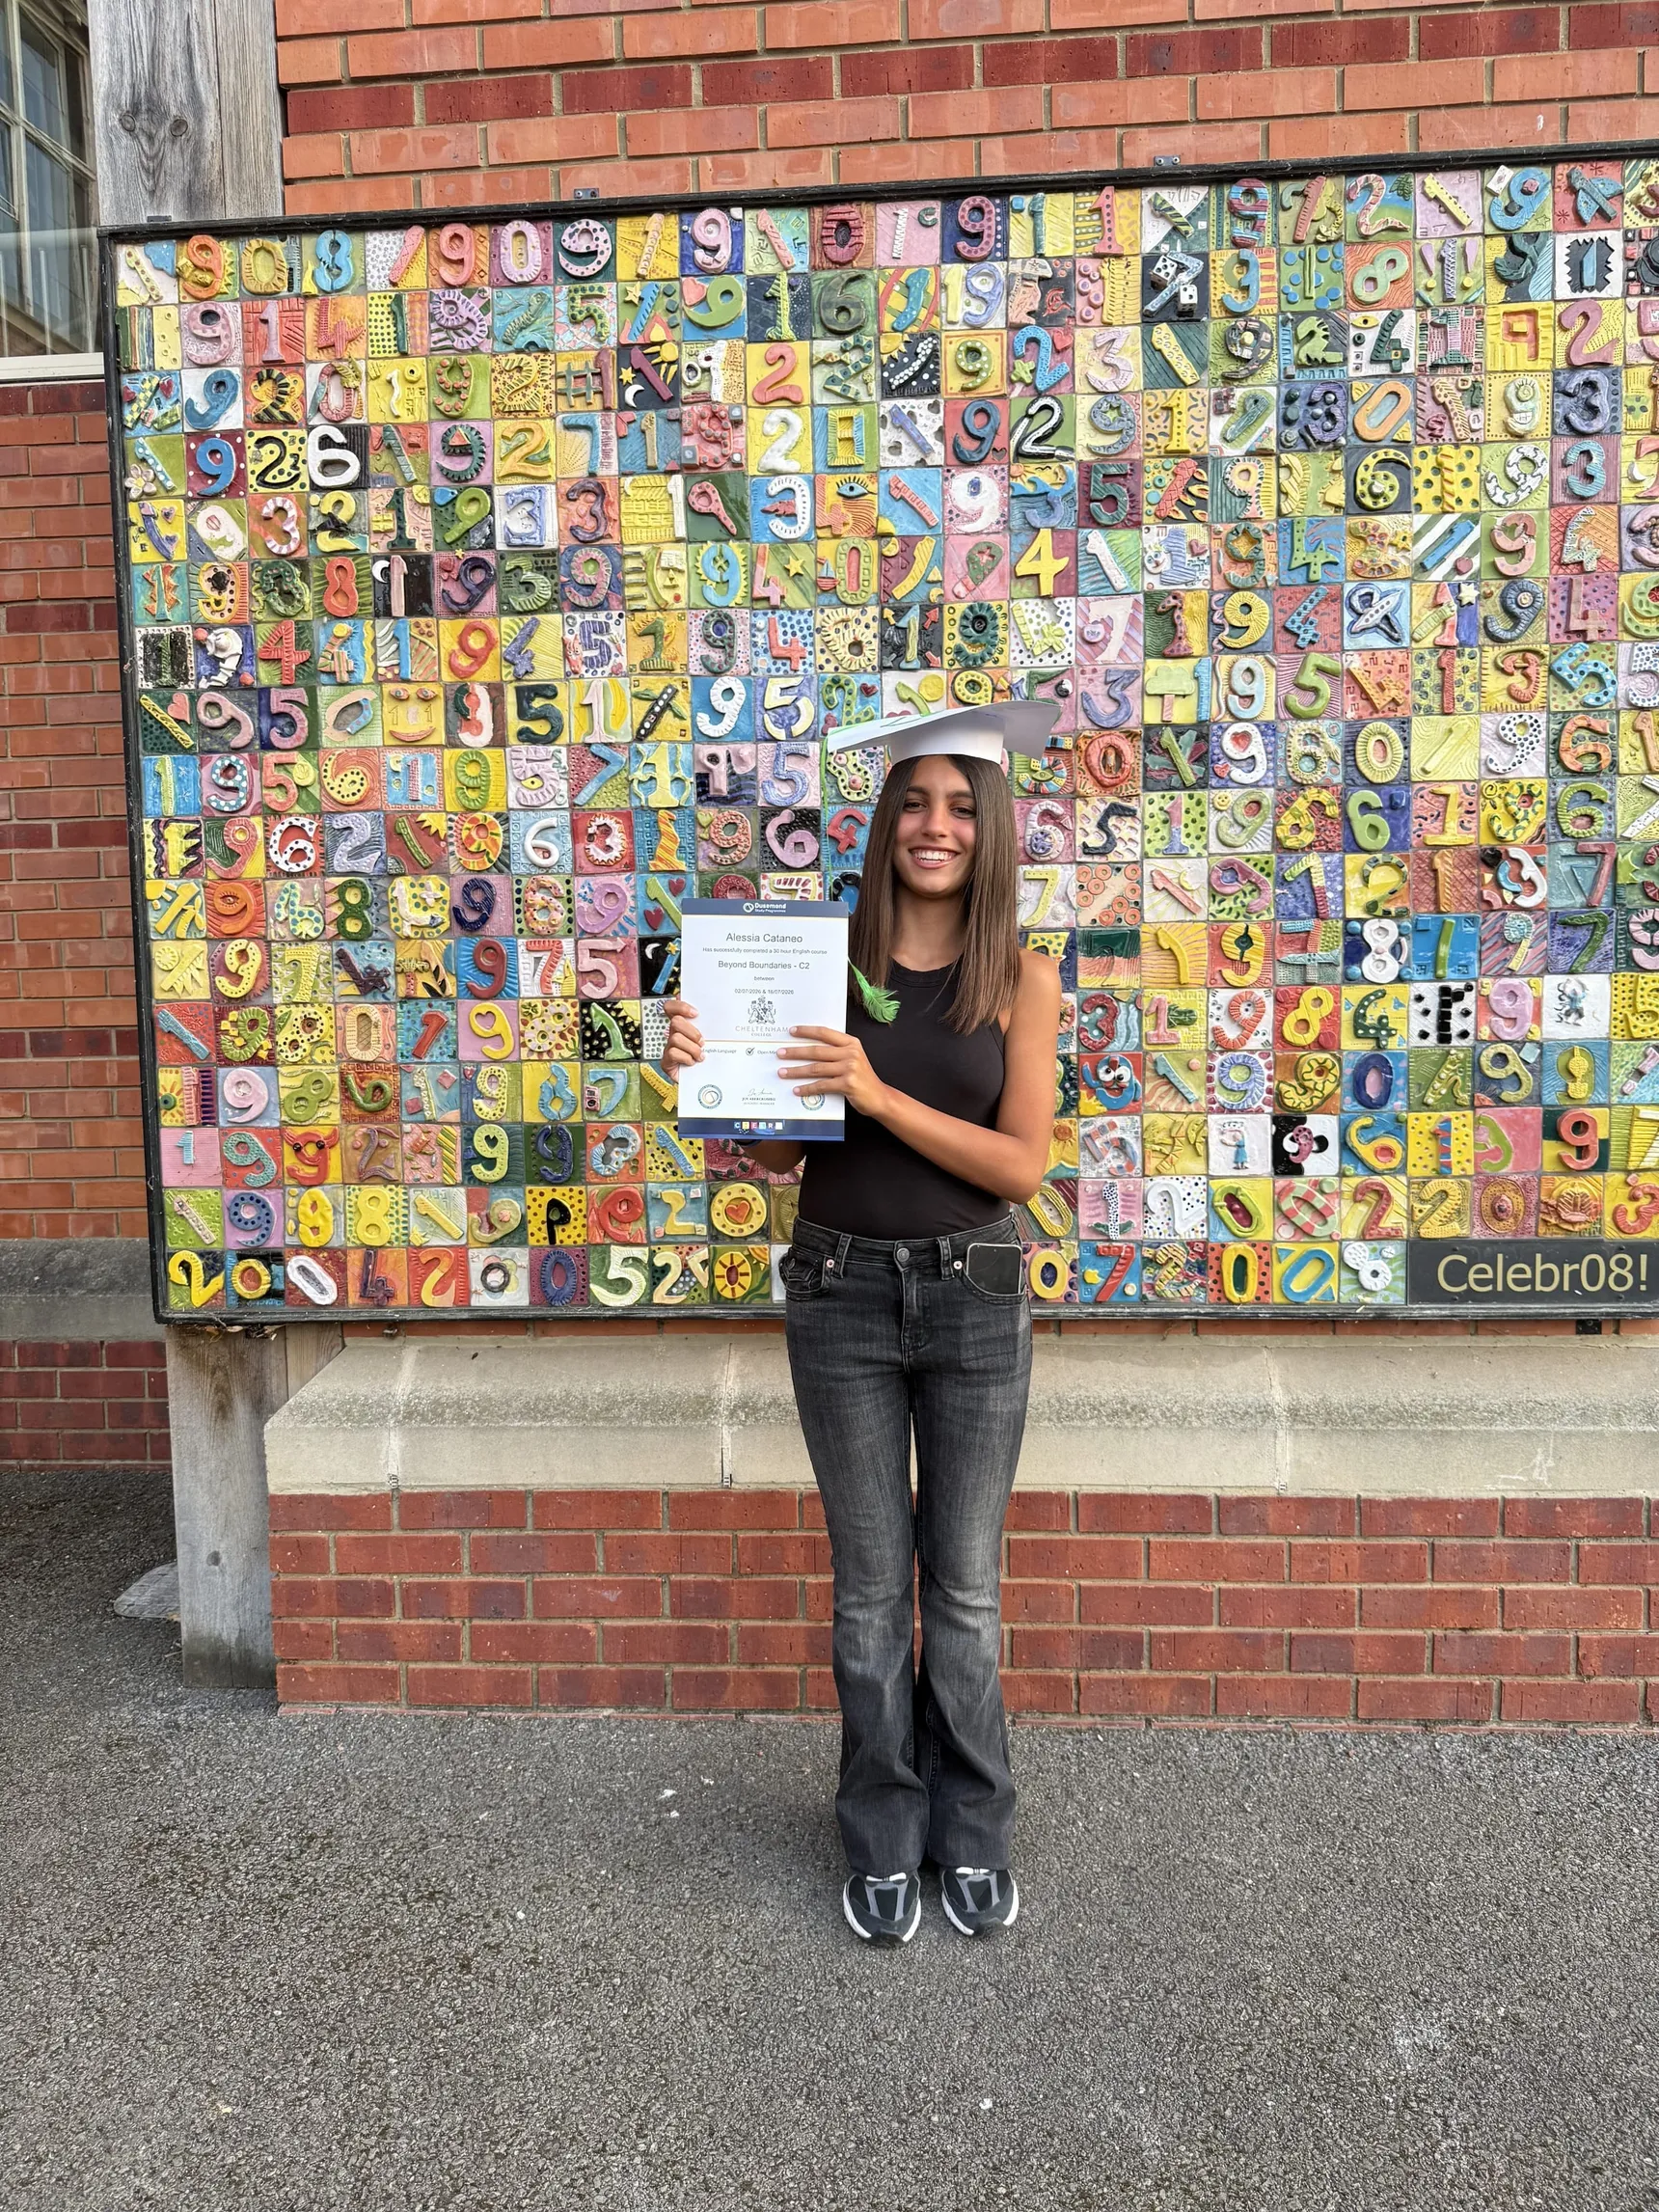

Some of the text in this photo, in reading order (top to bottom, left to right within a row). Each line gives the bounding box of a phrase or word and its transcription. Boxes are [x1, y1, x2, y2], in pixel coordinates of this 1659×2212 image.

[242, 175, 1409, 294] 0 8 9 0 9 9 9 1 9 2
[187, 247, 1408, 366] 9 1 5 9 6 8
[185, 299, 1619, 430] 9 2 9 2 2
[196, 381, 1411, 496] 9 2 6 2 2 9 9 1 0
[261, 440, 1606, 556] 3 1 9 3 9 5 6 9 3
[323, 518, 1340, 617] 8 9 9 9 0 4 4
[258, 580, 1544, 685] 4 9 4 5 9 4 9 4 9
[270, 676, 746, 750] 5 5 1 9
[1082, 642, 1618, 728] 3 9 5 5
[207, 742, 811, 811] 9 5 9 7 5
[1084, 714, 1612, 788] 0 9 0 9 6
[268, 808, 819, 874] 6 2 6 9 6
[1163, 782, 1609, 855] 1 9 6 1 6
[213, 876, 566, 941] 9 8 9 6
[1023, 869, 1059, 927] 7
[214, 938, 627, 999] 9 9 7 5
[718, 961, 748, 969] Beyond
[725, 932, 803, 943] Alessia Cataneo
[1219, 918, 1399, 987] 9 8
[470, 1002, 514, 1060] 9
[1079, 978, 1533, 1051] 3 8 9
[224, 1066, 507, 1123] 9 8 9
[1219, 1043, 1534, 1109] 9 0 9
[177, 1124, 508, 1188] 1 9 9
[1557, 1108, 1599, 1171] 9
[227, 1188, 392, 1247] 9 8
[1147, 1178, 1403, 1240] 2 2
[169, 1244, 687, 1307] 2 0 0 5 2
[1029, 1243, 1335, 1304] 0 7 0 0
[1437, 1253, 1647, 1293] Celebr08!
